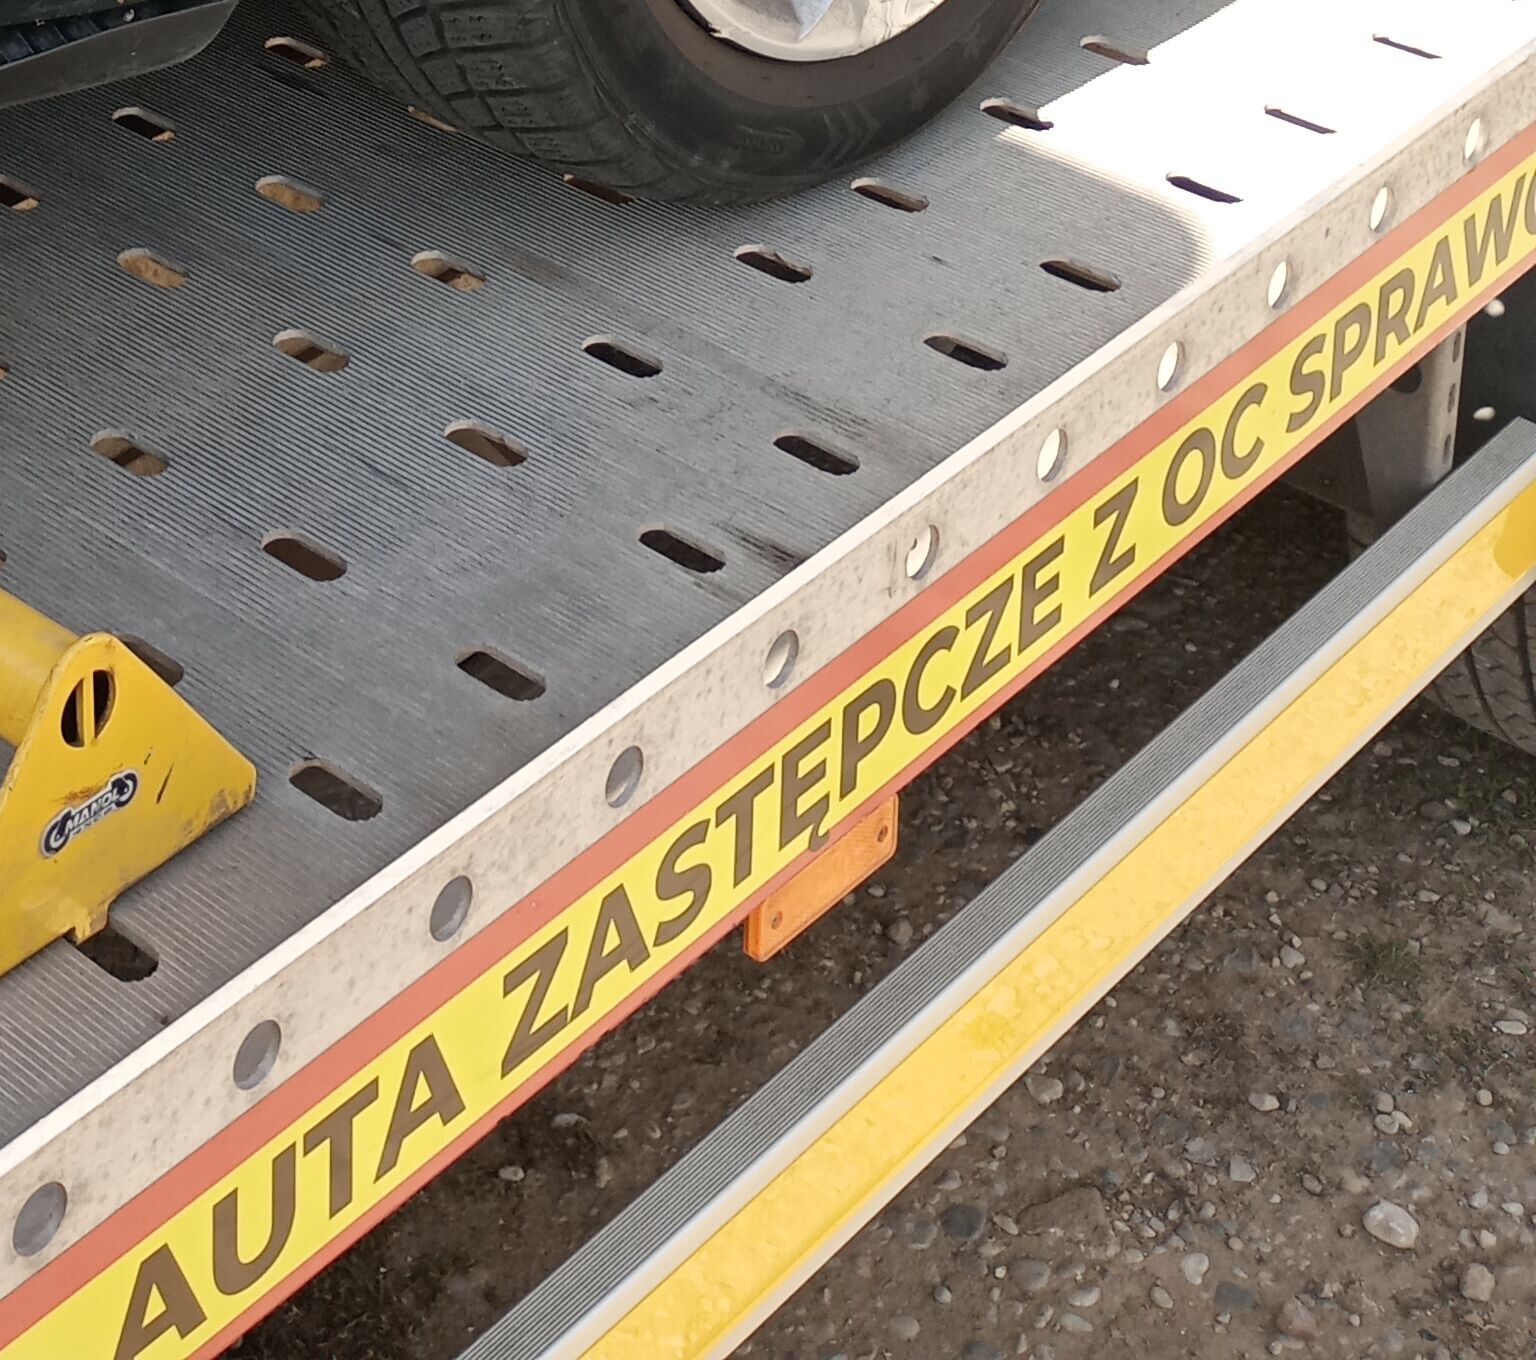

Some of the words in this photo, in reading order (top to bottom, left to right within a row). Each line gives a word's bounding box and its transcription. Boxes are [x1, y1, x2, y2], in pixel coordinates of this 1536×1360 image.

[112, 1032, 466, 1360] AUTA
[500, 536, 1067, 1080] ZASTĘPCZE
[1088, 476, 1140, 599] Z
[1161, 382, 1269, 526] OC
